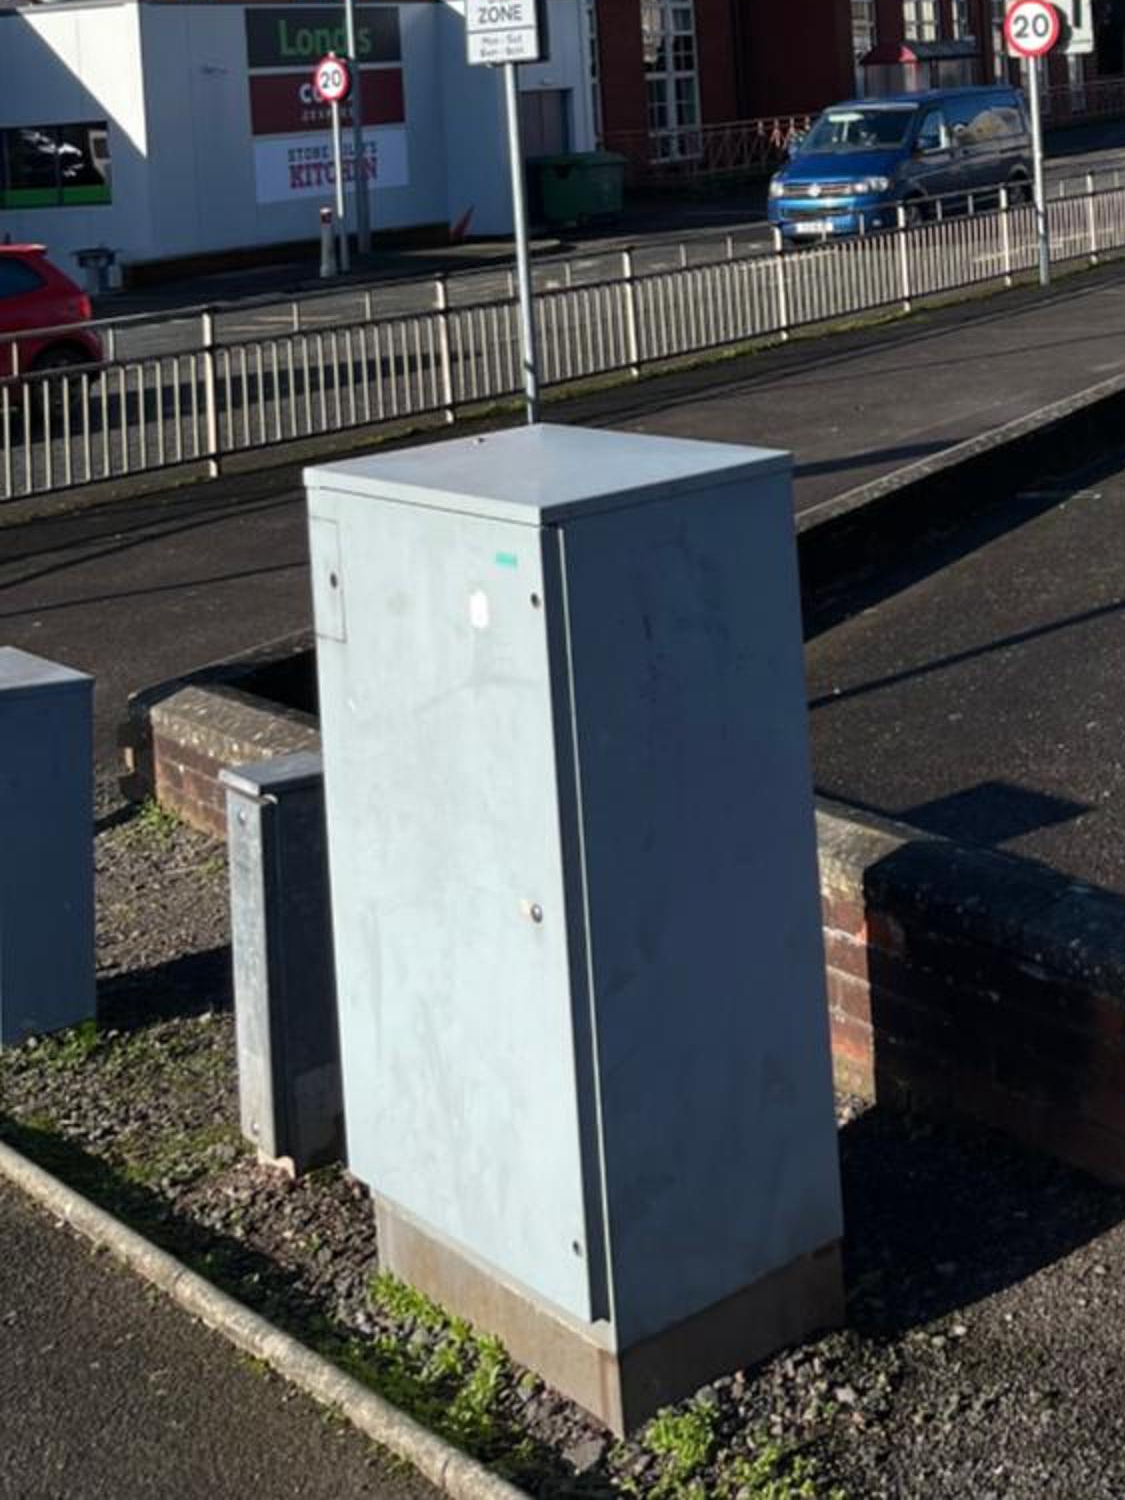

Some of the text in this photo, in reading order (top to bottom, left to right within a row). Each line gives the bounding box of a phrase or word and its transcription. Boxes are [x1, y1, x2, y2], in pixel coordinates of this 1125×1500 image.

[478, 3, 522, 24] ZONE
[1013, 13, 1049, 38] 20
[278, 19, 372, 56] Londs
[319, 69, 342, 89] 20
